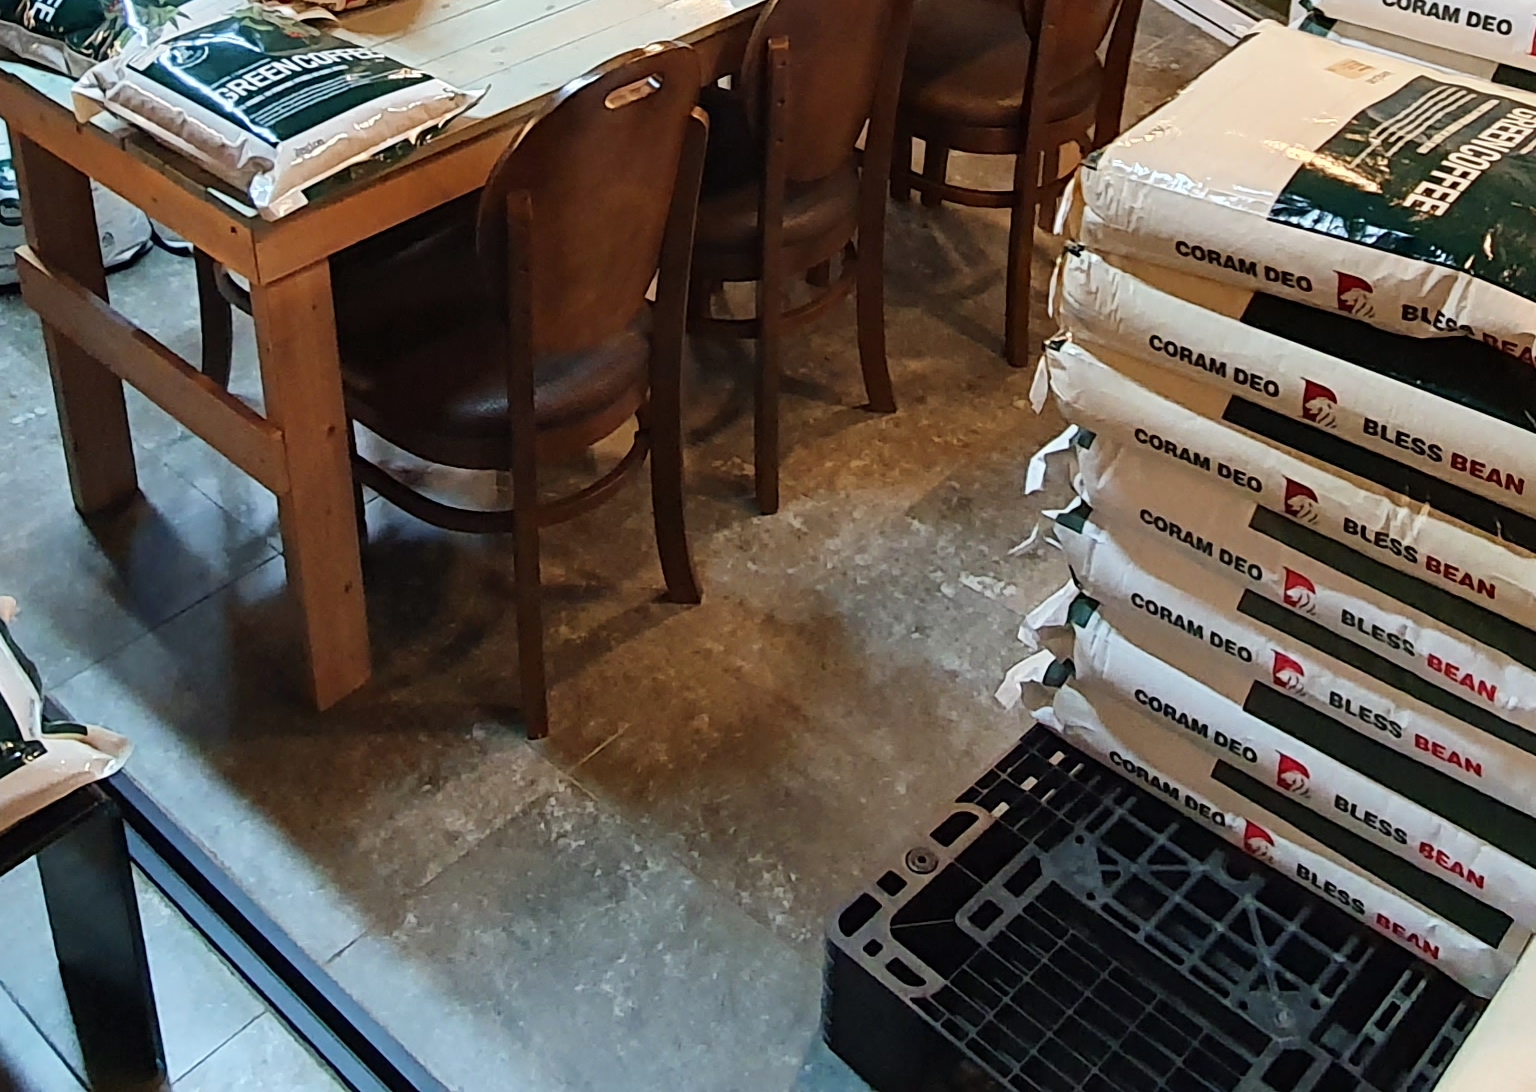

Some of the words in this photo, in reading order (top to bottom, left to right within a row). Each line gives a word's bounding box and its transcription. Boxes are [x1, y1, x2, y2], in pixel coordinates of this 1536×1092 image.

[217, 57, 297, 105] GREEN
[290, 46, 387, 72] COFFEE
[1466, 11, 1512, 36] DEO
[1403, 144, 1503, 217] COFFEE
[1175, 240, 1258, 278] CORAM
[1265, 264, 1313, 292] DEO
[1148, 334, 1227, 378] CORAM
[1233, 367, 1280, 398] DEO
[1363, 417, 1443, 463] BLESS
[1450, 451, 1525, 496] BEAN
[1134, 427, 1211, 471] CORAM
[1217, 461, 1263, 494] DEO
[1343, 517, 1418, 564] BLESS
[1425, 554, 1496, 600] BEAN
[1131, 592, 1204, 641] CORAM
[1209, 630, 1253, 663] DEO
[1328, 690, 1403, 740] BLESS
[1414, 733, 1483, 778] BEAN
[1139, 508, 1213, 557] CORAM
[1219, 547, 1263, 581] DEO
[1341, 608, 1415, 657] BLESS
[1427, 653, 1497, 702] BEAN
[1109, 750, 1180, 802] CORAM
[1184, 793, 1226, 827] DEO
[1296, 862, 1367, 916] BLESS
[1376, 912, 1441, 961] BEAN
[1134, 688, 1209, 740] CORAM
[1214, 730, 1258, 764] DEO
[1334, 794, 1409, 846] BLESS
[1418, 840, 1485, 890] BEAN
